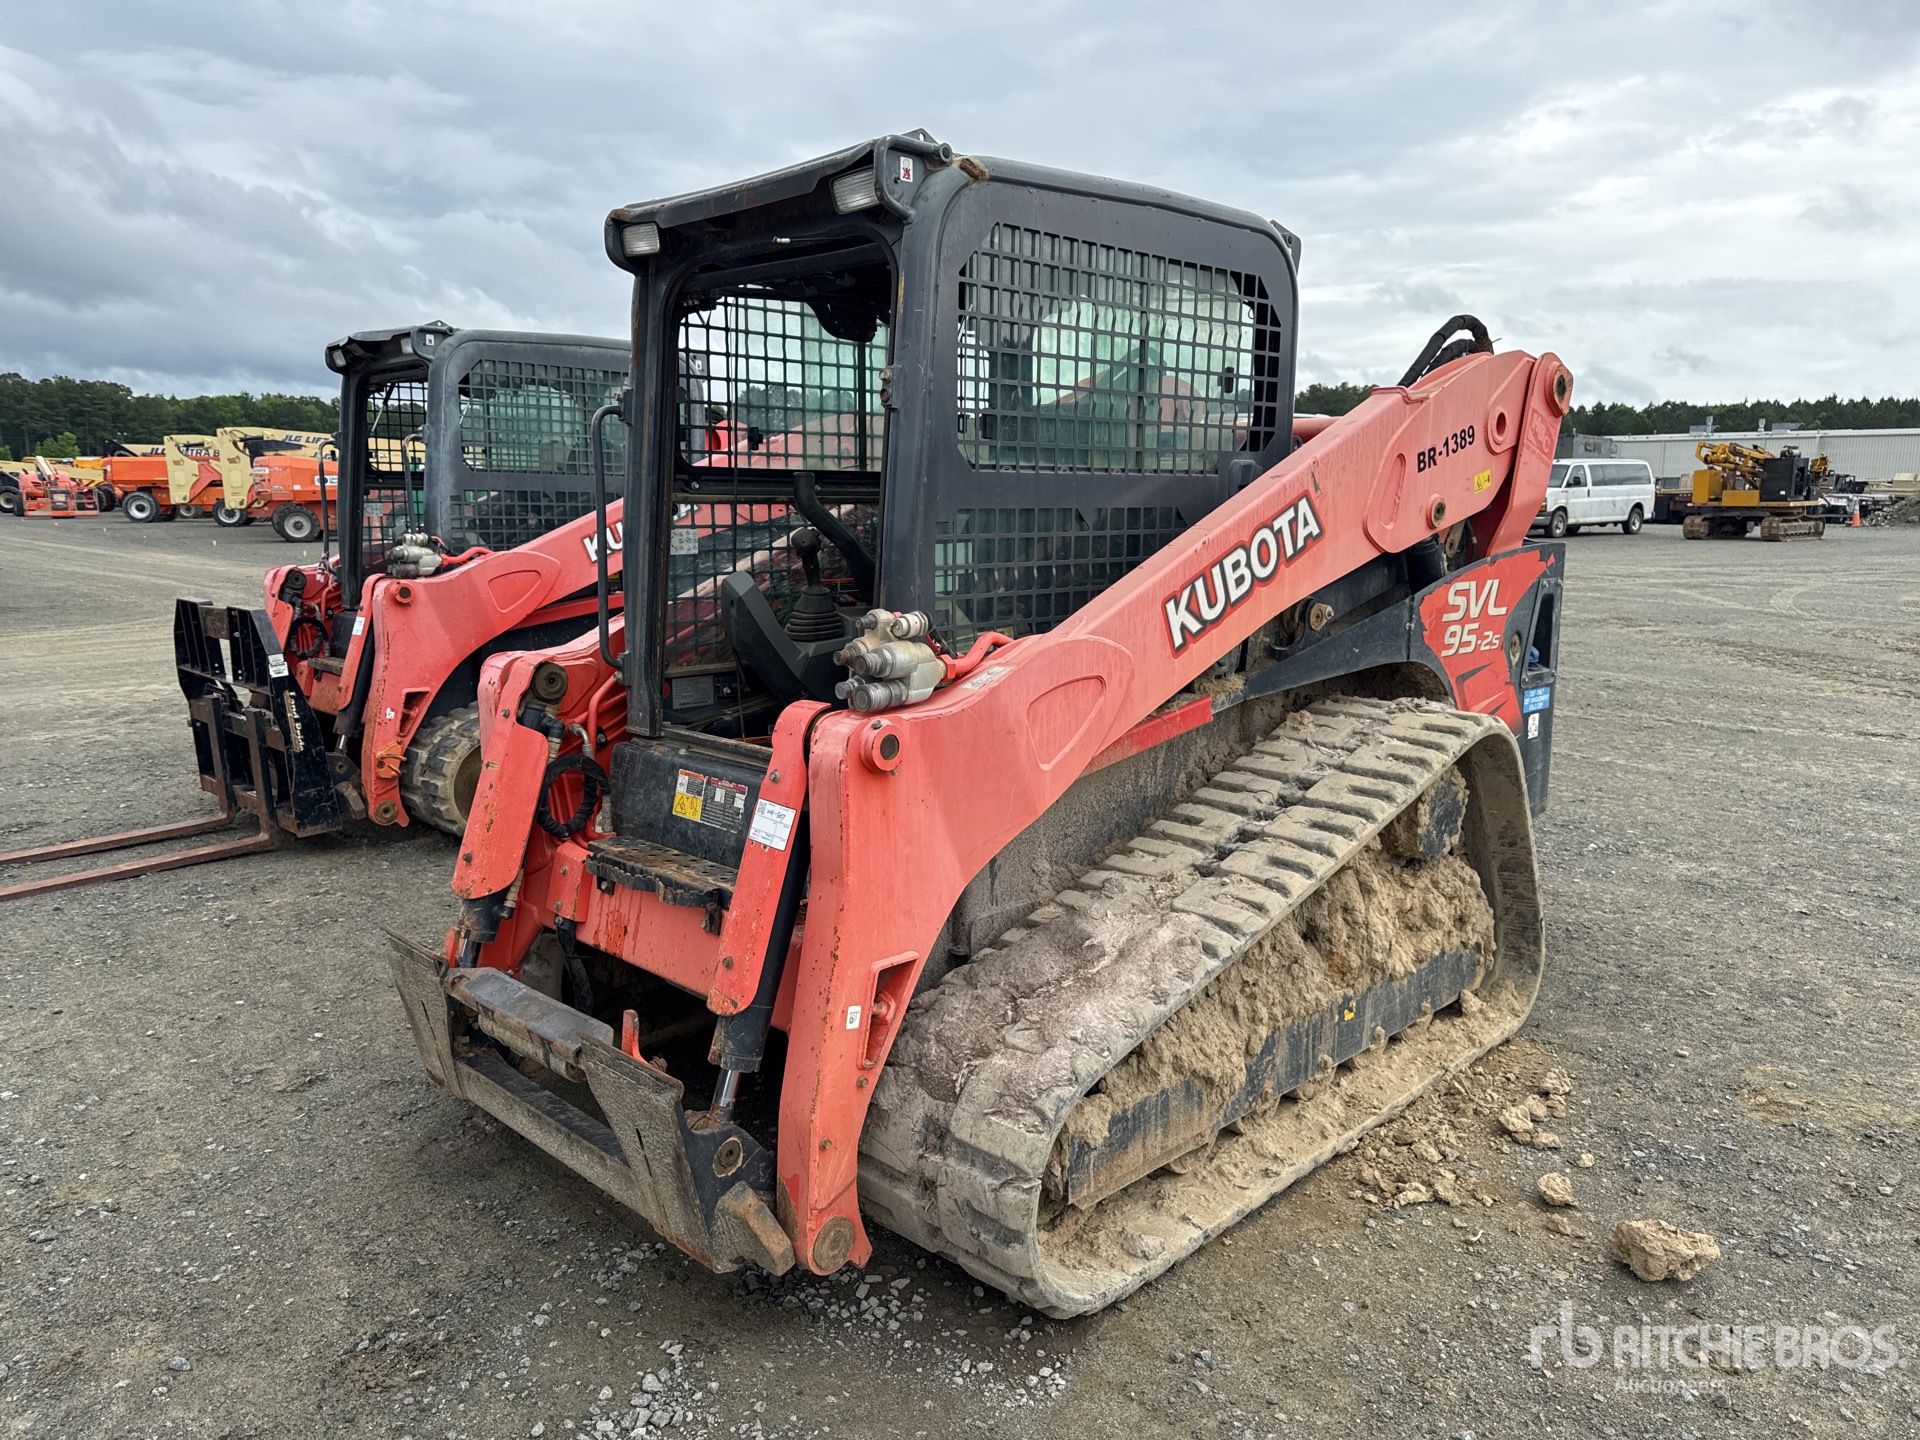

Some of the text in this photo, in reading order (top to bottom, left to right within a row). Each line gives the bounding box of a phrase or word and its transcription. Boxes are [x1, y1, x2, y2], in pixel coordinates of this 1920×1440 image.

[1417, 424, 1475, 474] BR-1389
[1164, 495, 1323, 651] KUBOTA
[1442, 579, 1508, 622] SVL
